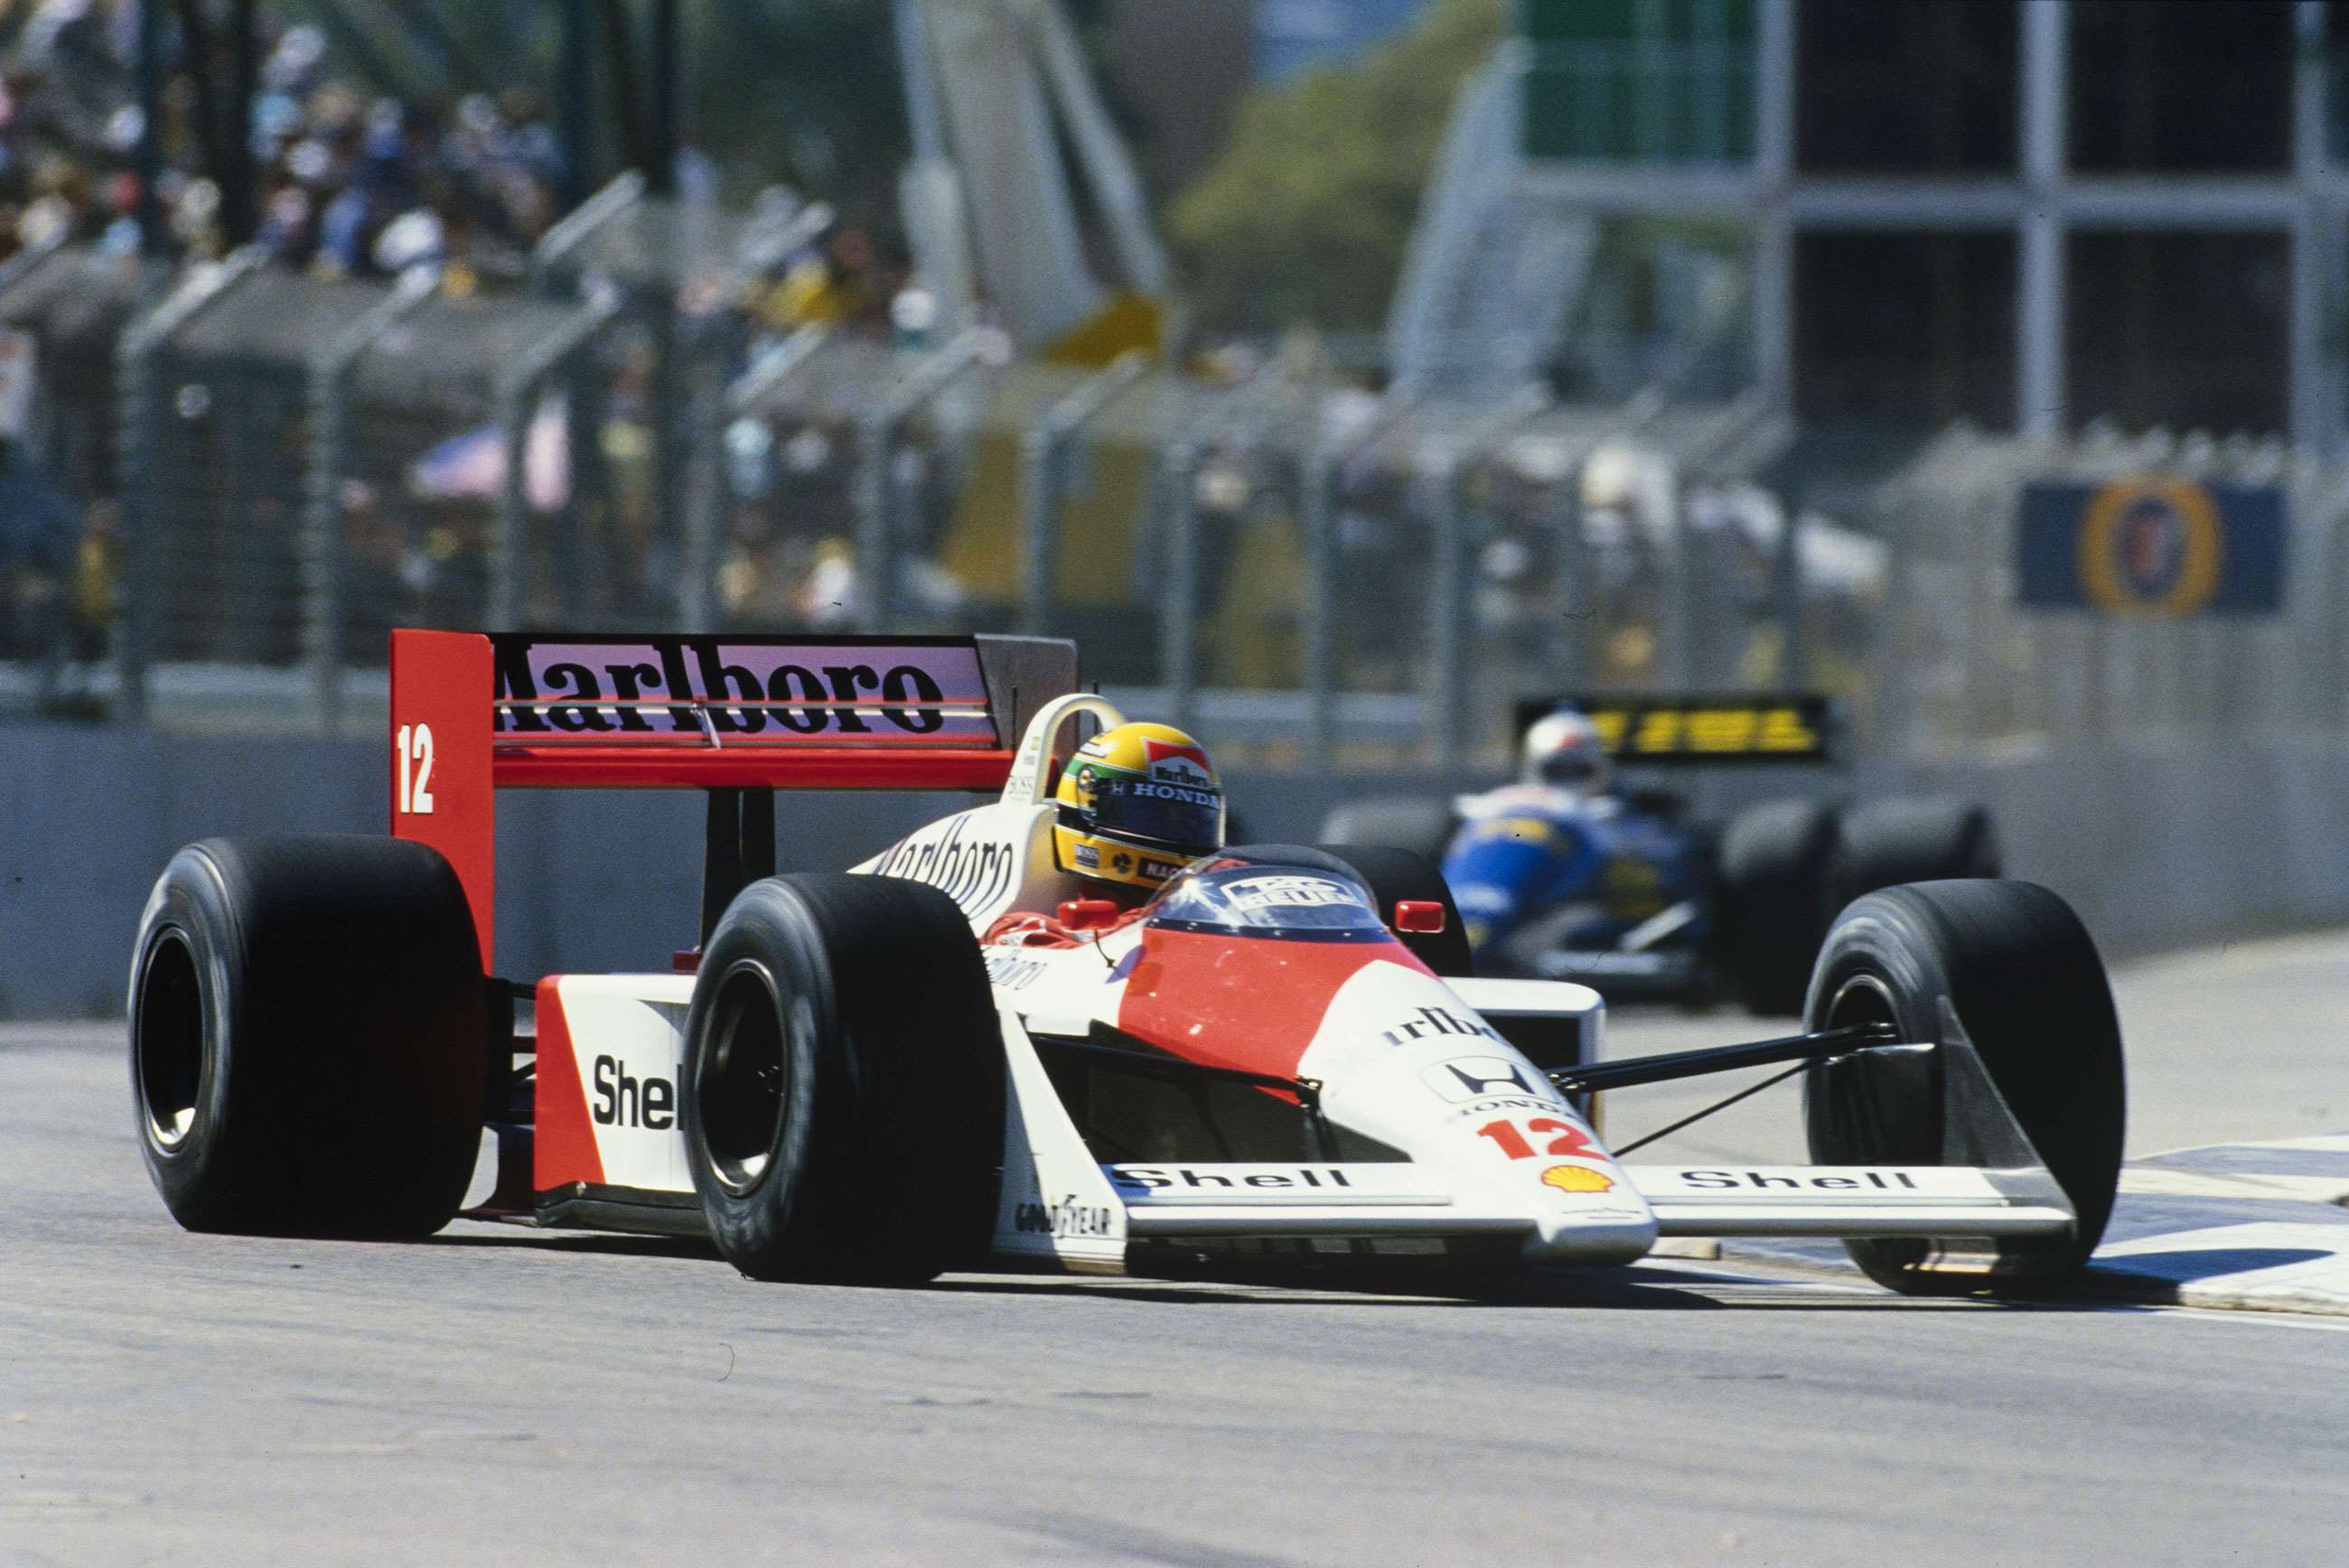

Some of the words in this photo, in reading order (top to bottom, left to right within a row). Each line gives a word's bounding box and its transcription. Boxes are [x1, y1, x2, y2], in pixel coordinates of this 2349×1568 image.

[398, 723, 435, 815] 12
[1476, 1117, 1612, 1162] 12
[1110, 1169, 1351, 1188] Shell
[1680, 1171, 1917, 1190] Shell
